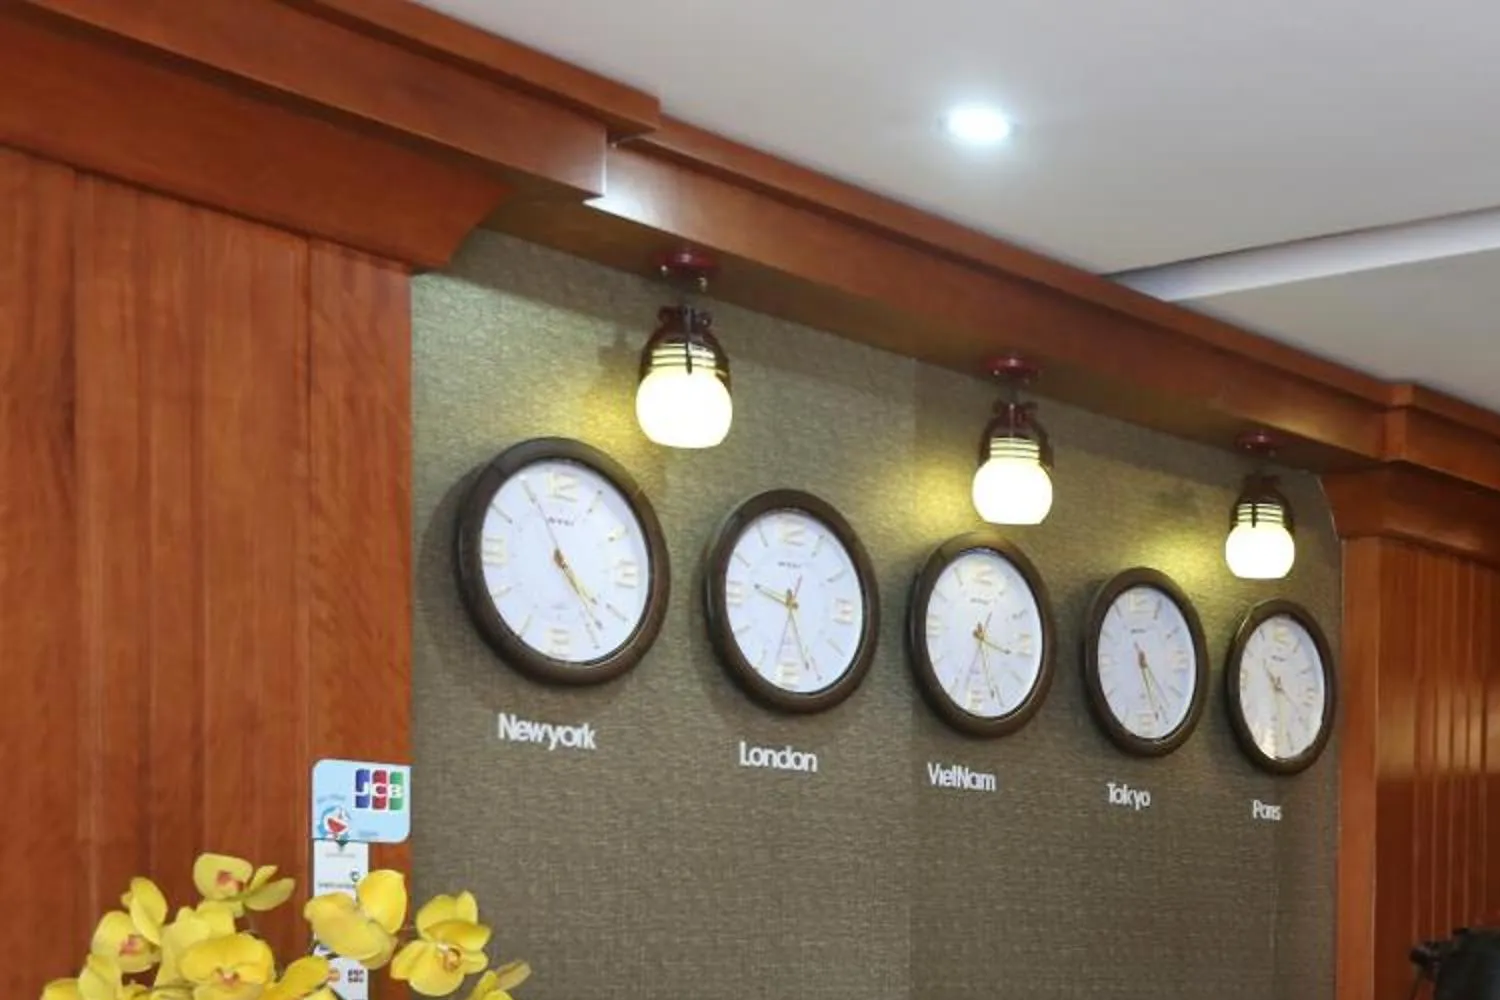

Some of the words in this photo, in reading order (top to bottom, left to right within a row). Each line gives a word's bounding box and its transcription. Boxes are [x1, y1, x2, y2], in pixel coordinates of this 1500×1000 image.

[498, 711, 596, 751] Newyork
[739, 741, 817, 773] London
[1106, 783, 1151, 811] Tokyo
